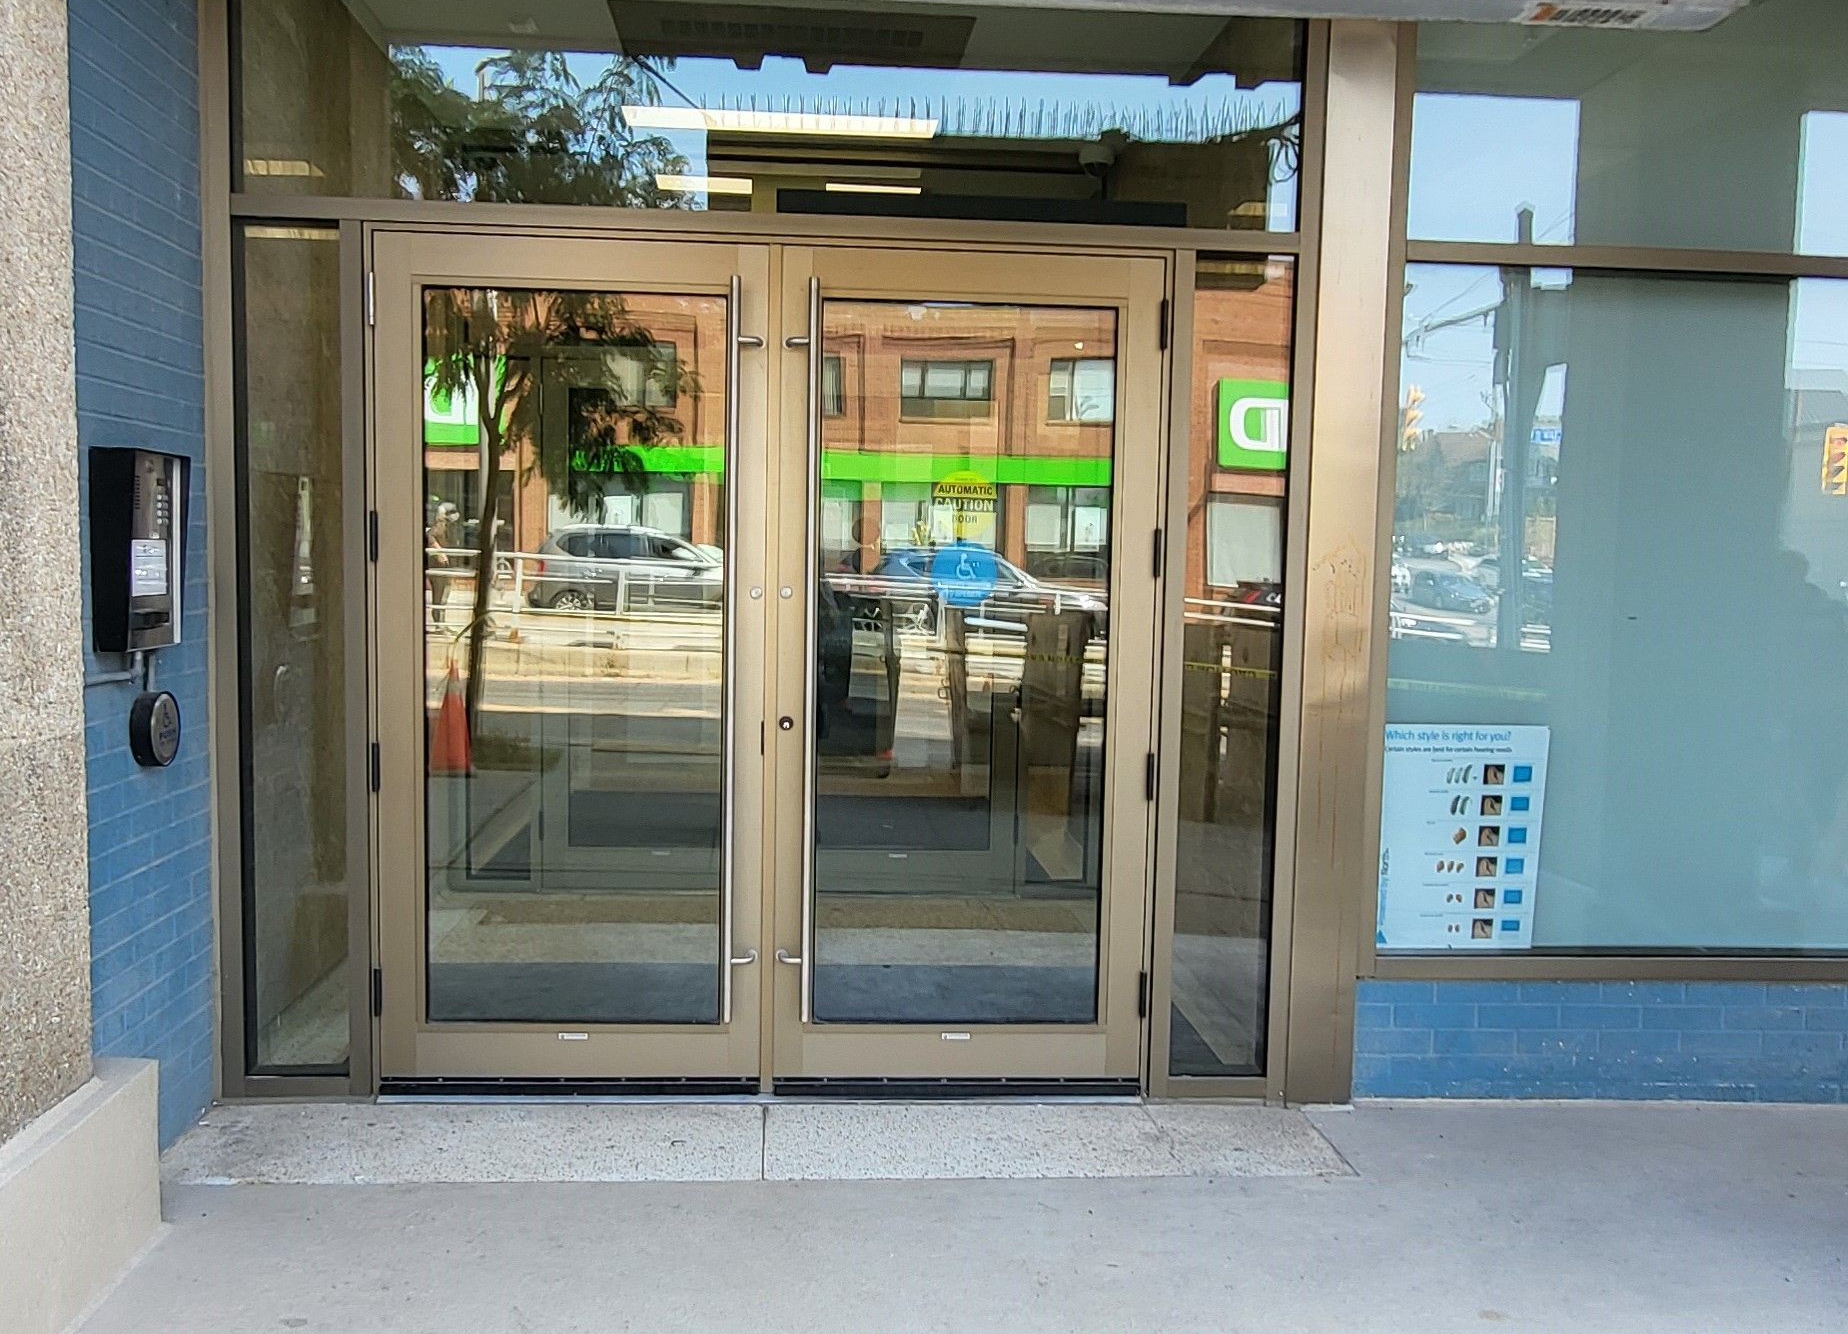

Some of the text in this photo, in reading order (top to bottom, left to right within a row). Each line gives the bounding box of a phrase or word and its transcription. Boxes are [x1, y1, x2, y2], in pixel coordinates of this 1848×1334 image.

[938, 484, 993, 496] AUTOMATIC
[934, 497, 994, 512] CAUTION
[1386, 730, 1512, 743] Which style is right for you?
